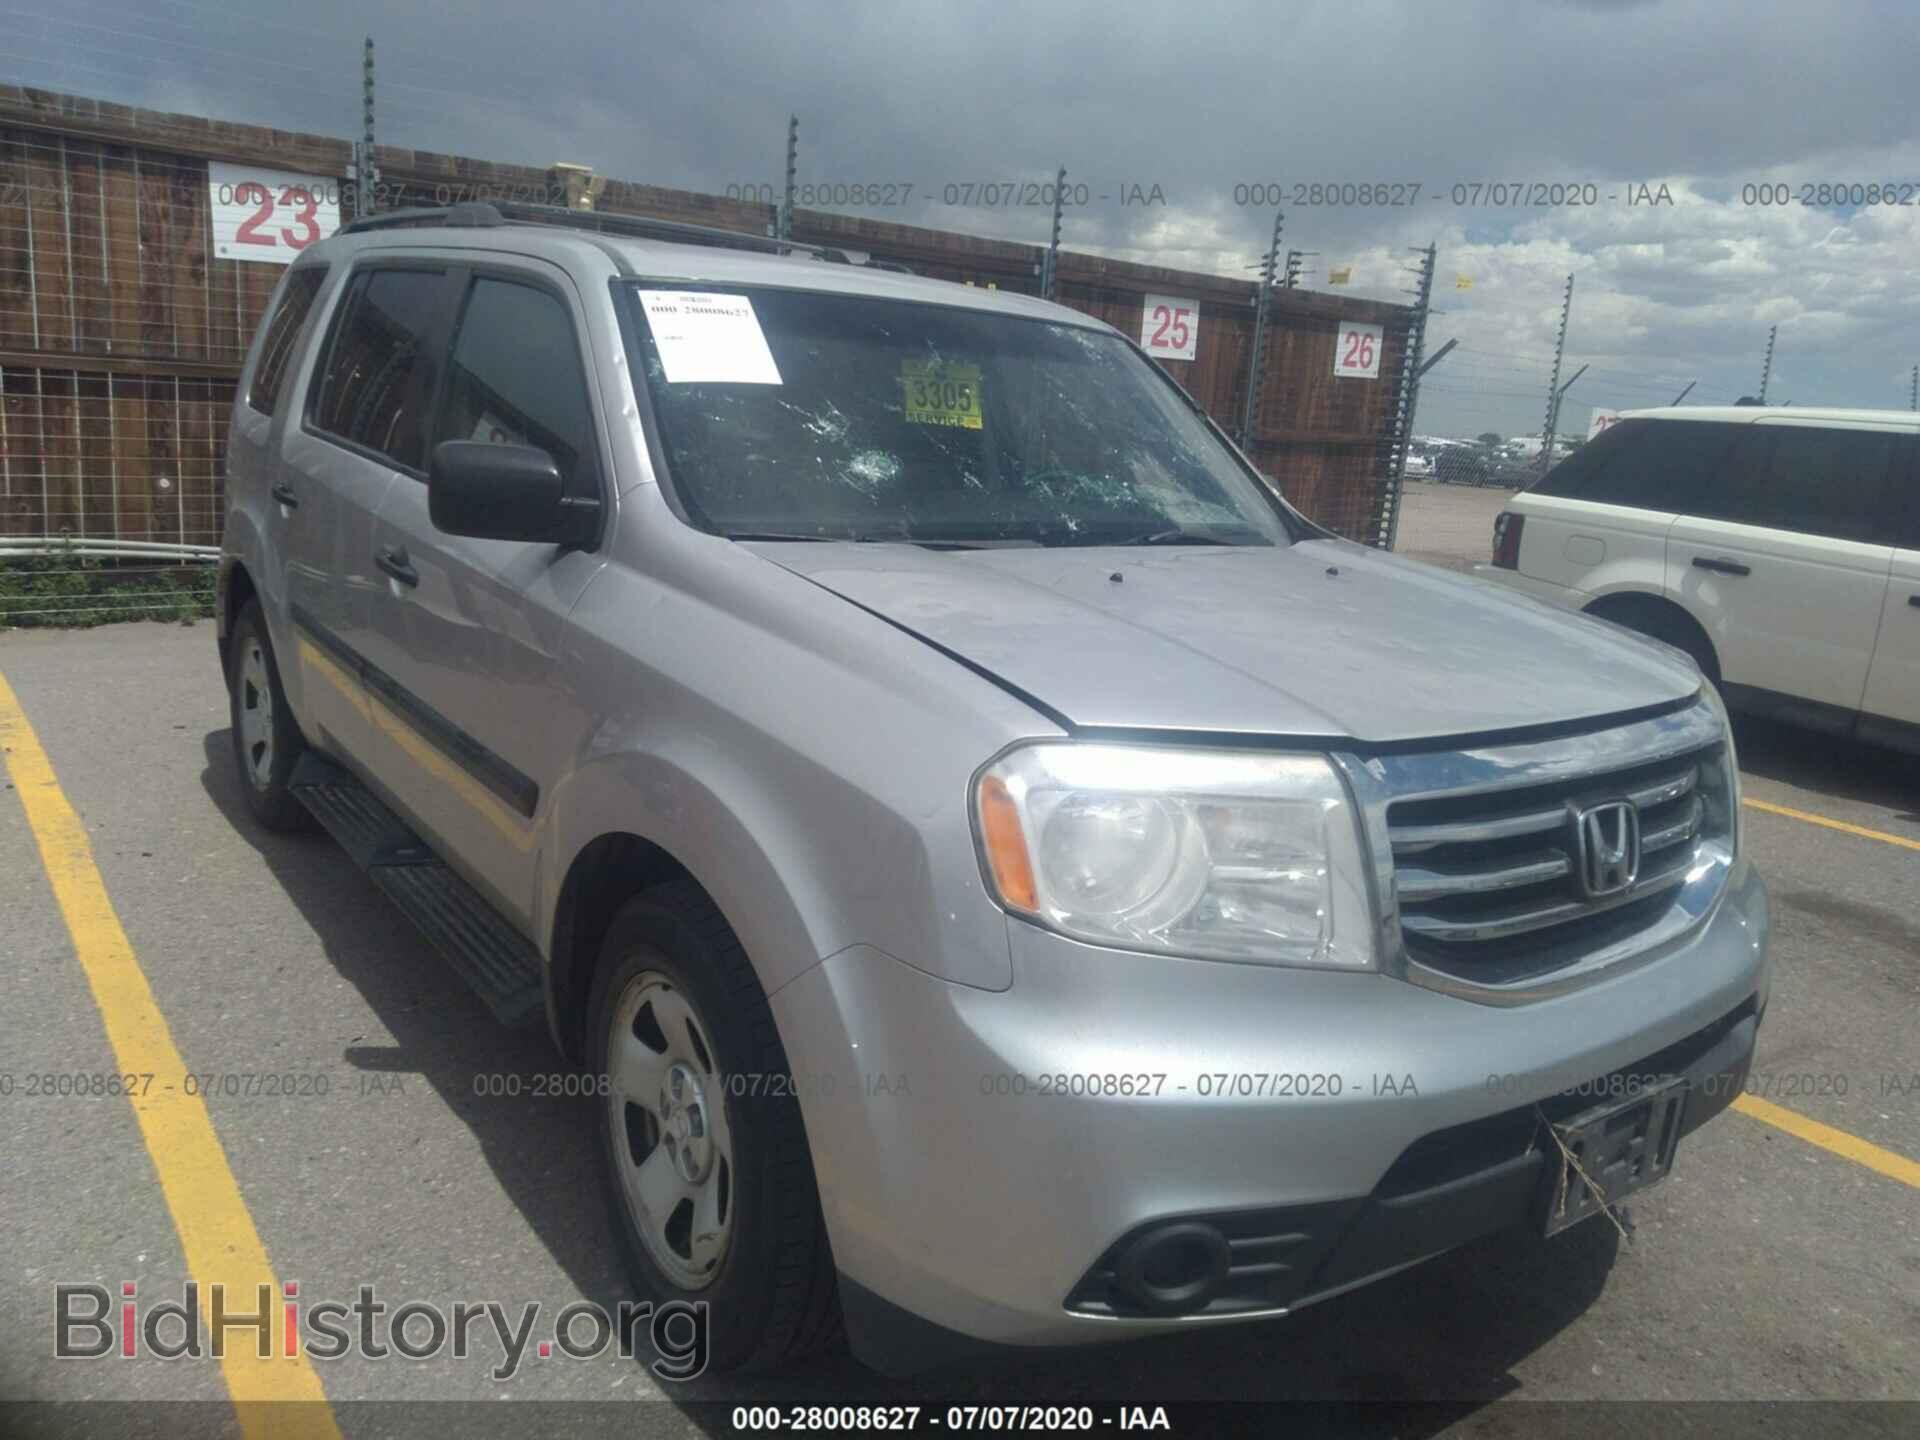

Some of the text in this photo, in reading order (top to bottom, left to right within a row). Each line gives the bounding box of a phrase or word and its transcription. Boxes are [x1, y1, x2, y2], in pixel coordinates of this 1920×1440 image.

[235, 181, 321, 250] 23
[1150, 304, 1191, 350] 25
[1342, 330, 1374, 369] 26
[913, 380, 972, 411] 3305
